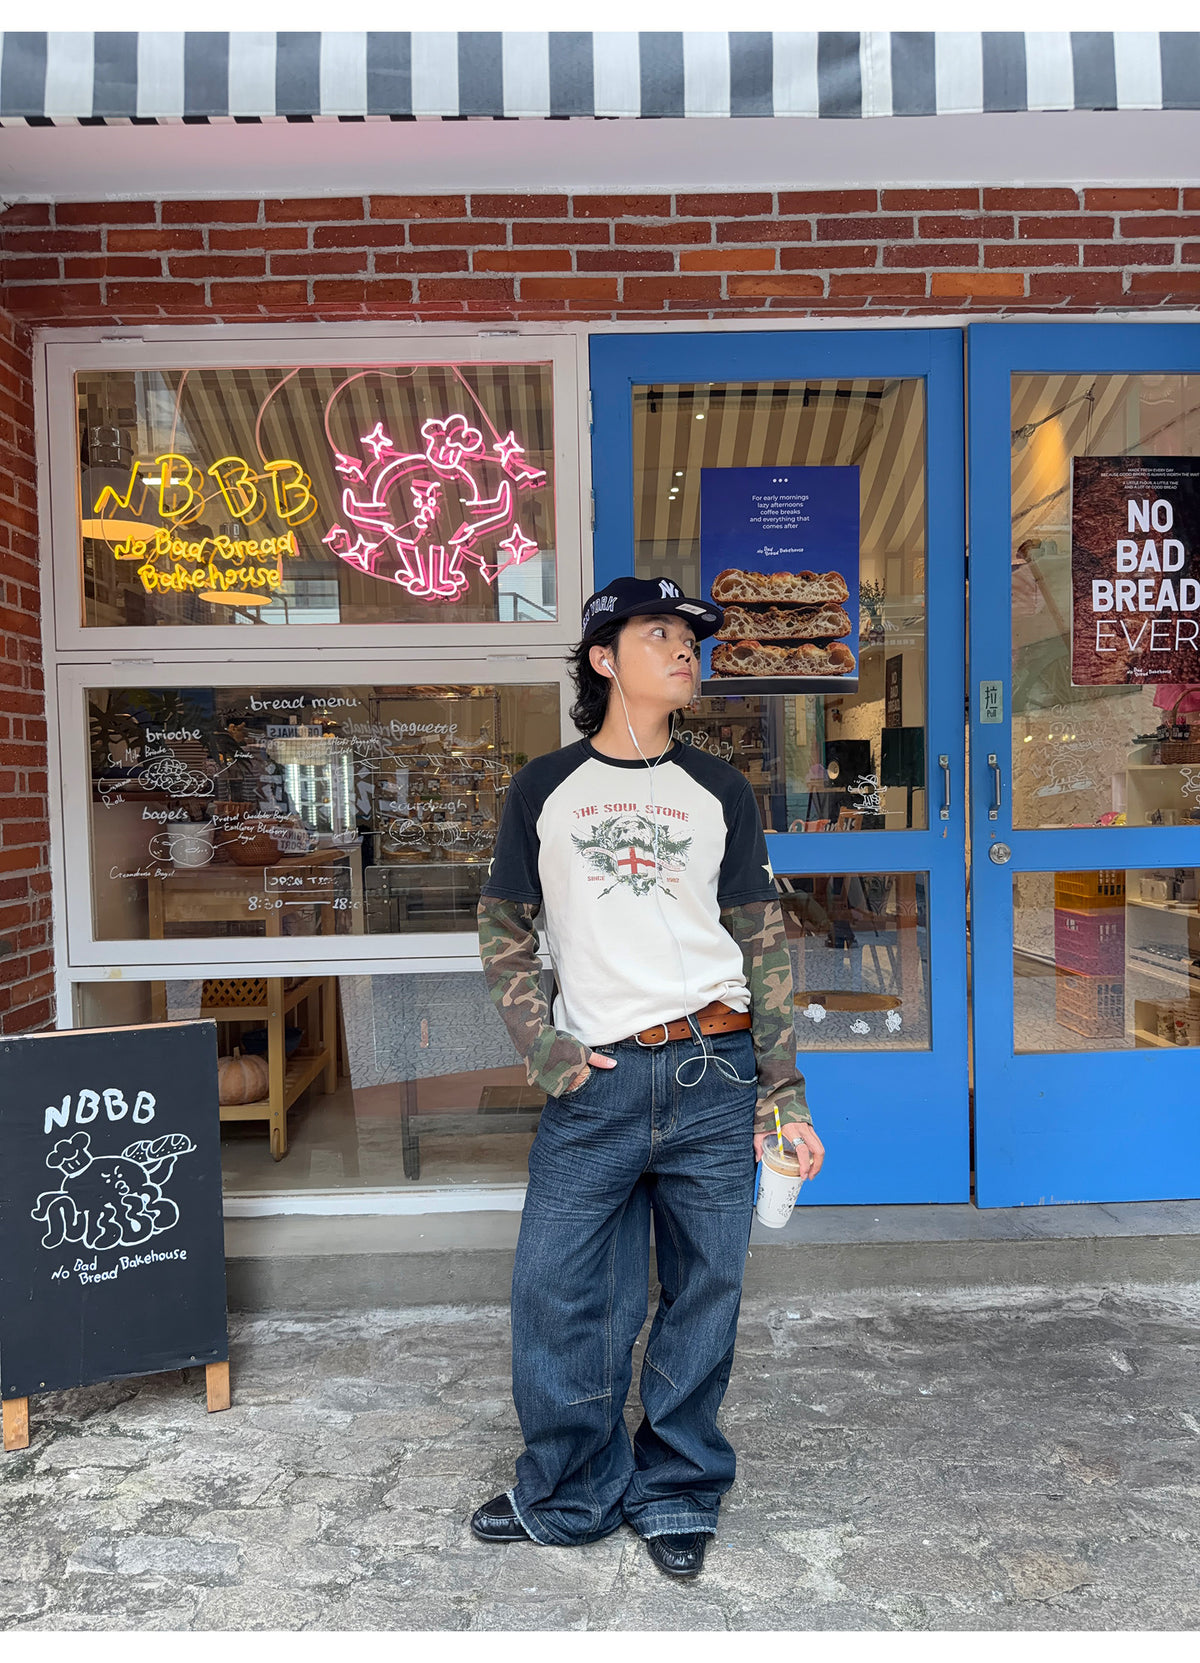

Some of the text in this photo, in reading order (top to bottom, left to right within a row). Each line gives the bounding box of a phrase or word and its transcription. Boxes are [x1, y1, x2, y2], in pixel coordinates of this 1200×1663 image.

[1128, 499, 1174, 532] NO
[213, 530, 294, 559] Bread
[1116, 539, 1185, 572] BAD
[590, 596, 618, 616] YORK
[1092, 579, 1200, 612] BREAD
[1096, 620, 1200, 652] EVER
[985, 686, 998, 709] 拉
[146, 727, 202, 743] brioche
[391, 720, 458, 736] baguette
[102, 795, 125, 809] Roll
[390, 799, 467, 813] sourdough
[573, 803, 689, 822] THE SOUL STORE
[142, 807, 189, 824] bagels
[44, 1088, 156, 1134] NBBB
[51, 1256, 97, 1280] No Bad
[79, 1249, 187, 1285] Bread Bakehouse
